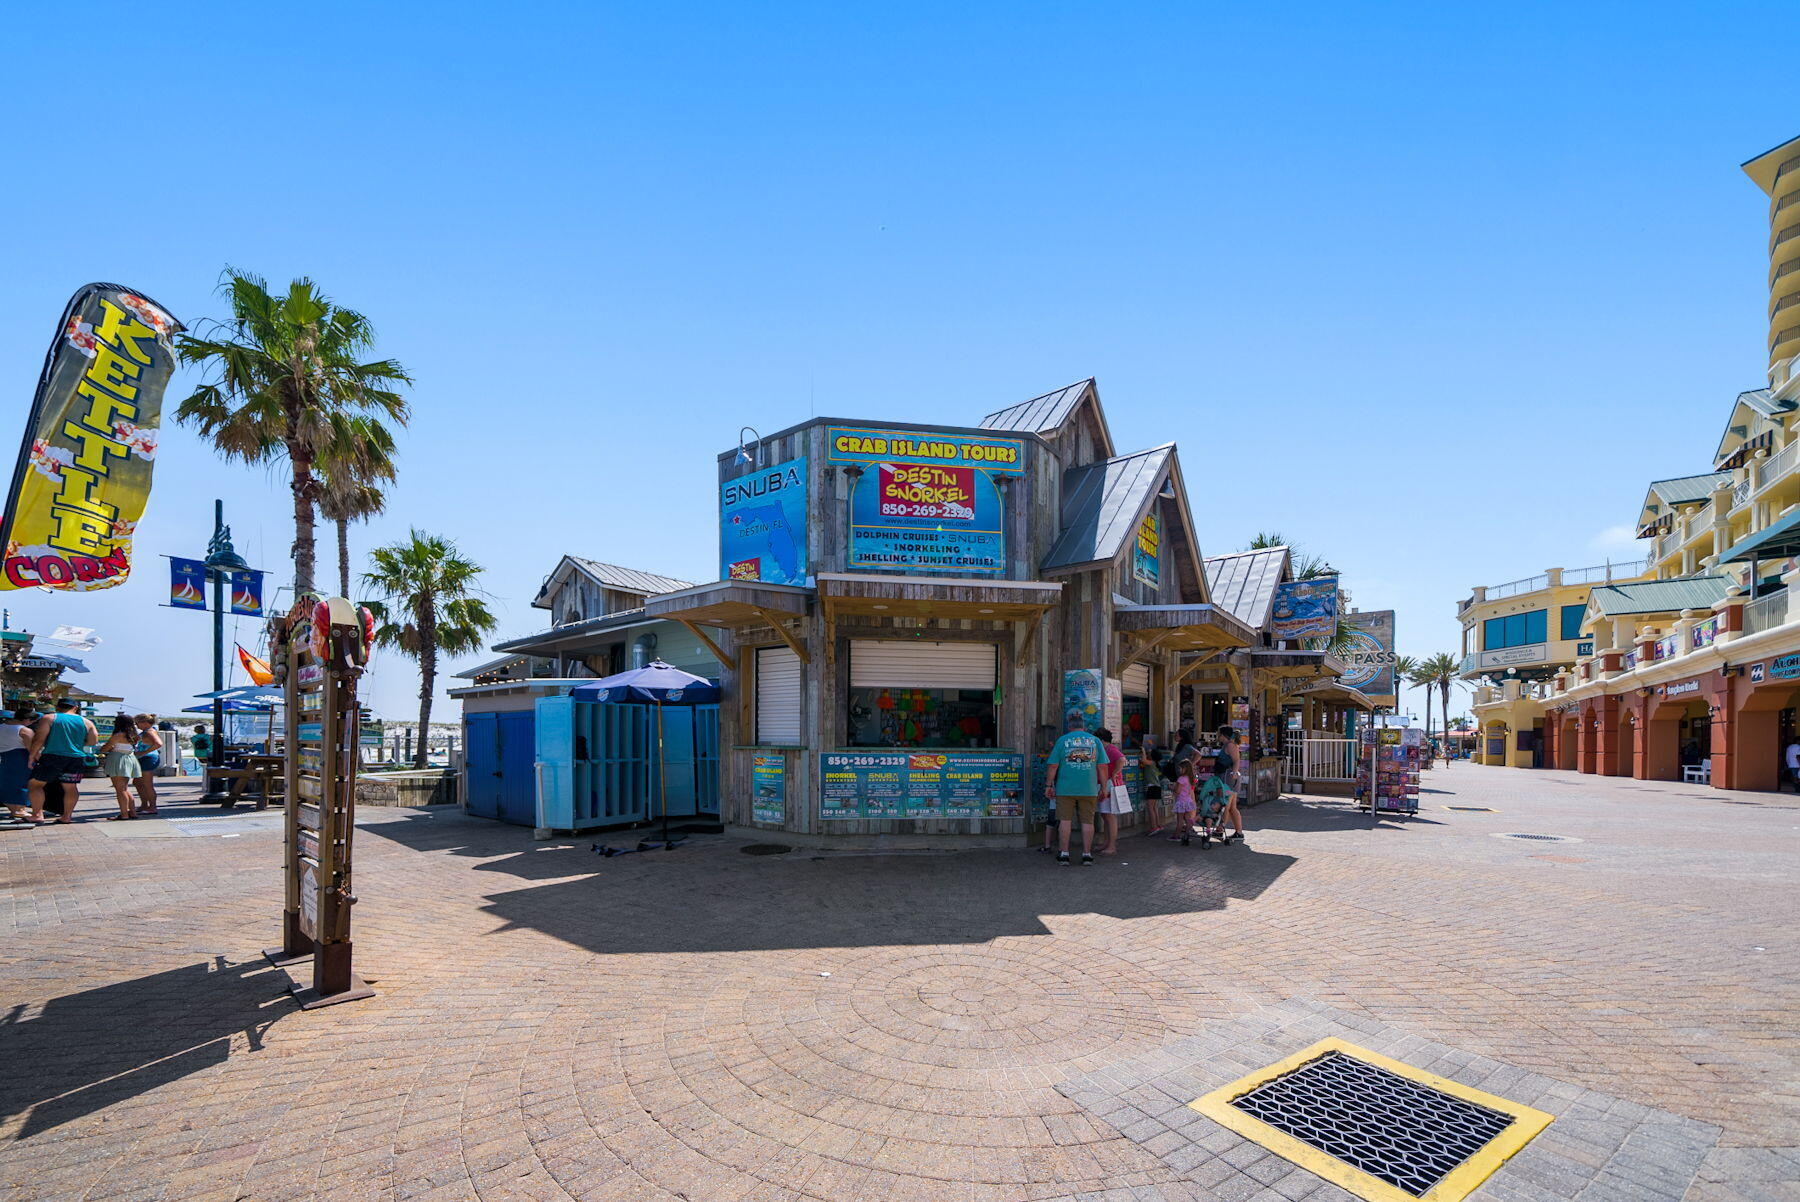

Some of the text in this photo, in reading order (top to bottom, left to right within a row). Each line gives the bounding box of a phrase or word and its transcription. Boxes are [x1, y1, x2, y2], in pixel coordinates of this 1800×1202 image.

[47, 297, 157, 559] KETTLE
[836, 436, 1017, 463] CRAB ISLAND TOURS
[893, 467, 957, 486] DESTIN
[725, 469, 800, 506] SNUBA
[886, 483, 969, 504] SNORKEL
[882, 504, 974, 518] 850-269-2329
[773, 520, 784, 528] FL
[885, 518, 972, 527] www.destinsnorkel.com
[856, 530, 996, 544] DOLPHIN CRUISES SNUBA
[894, 544, 960, 553] SNORKELING
[858, 554, 994, 566] SHELLING SUNSET CRUISES
[4, 547, 128, 588] CORN
[732, 562, 756, 576] DESTIN
[1354, 652, 1396, 664] PASS
[828, 756, 906, 766] 850-269-2329
